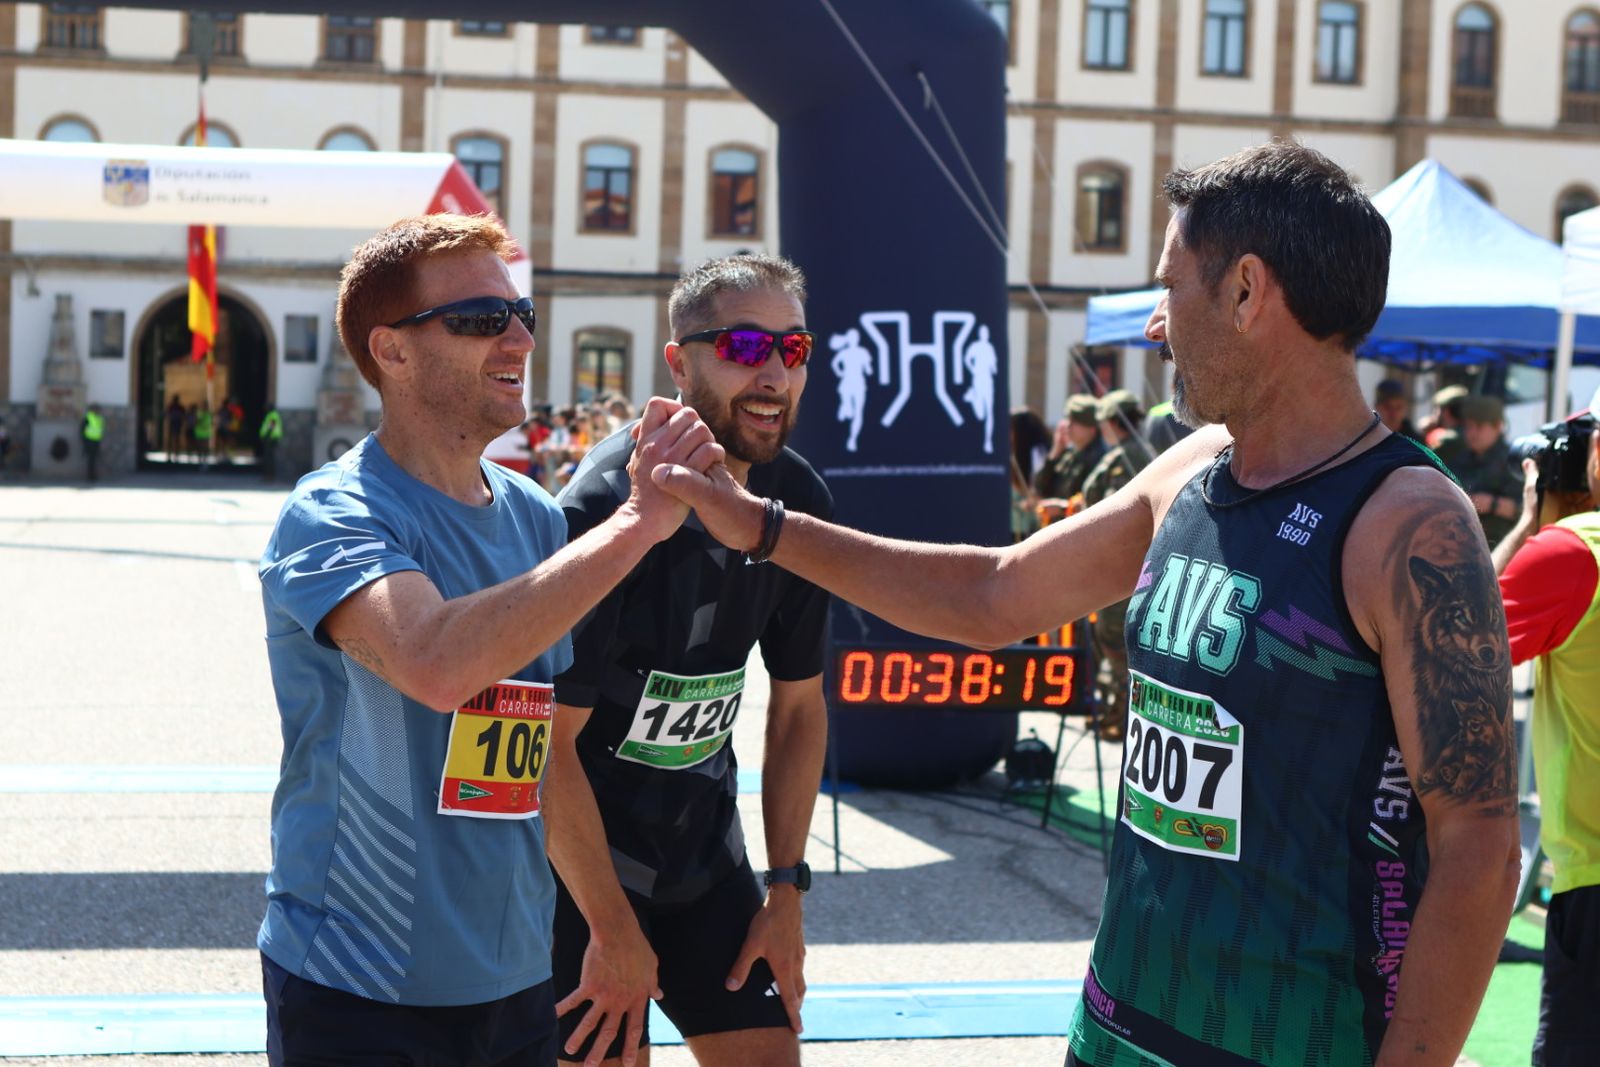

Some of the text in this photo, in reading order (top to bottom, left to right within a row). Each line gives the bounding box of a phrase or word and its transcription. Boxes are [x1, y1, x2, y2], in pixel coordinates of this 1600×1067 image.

[1276, 521, 1311, 546] 1990
[1288, 502, 1322, 528] AVS
[1139, 552, 1262, 677] AVS
[649, 675, 686, 699] XIV
[841, 651, 1074, 706] 00:38:19
[642, 690, 741, 742] 1420
[1146, 700, 1191, 731] CARRERA
[477, 719, 546, 779] 106
[1125, 717, 1234, 810] 2007
[1374, 746, 1411, 819] AVS
